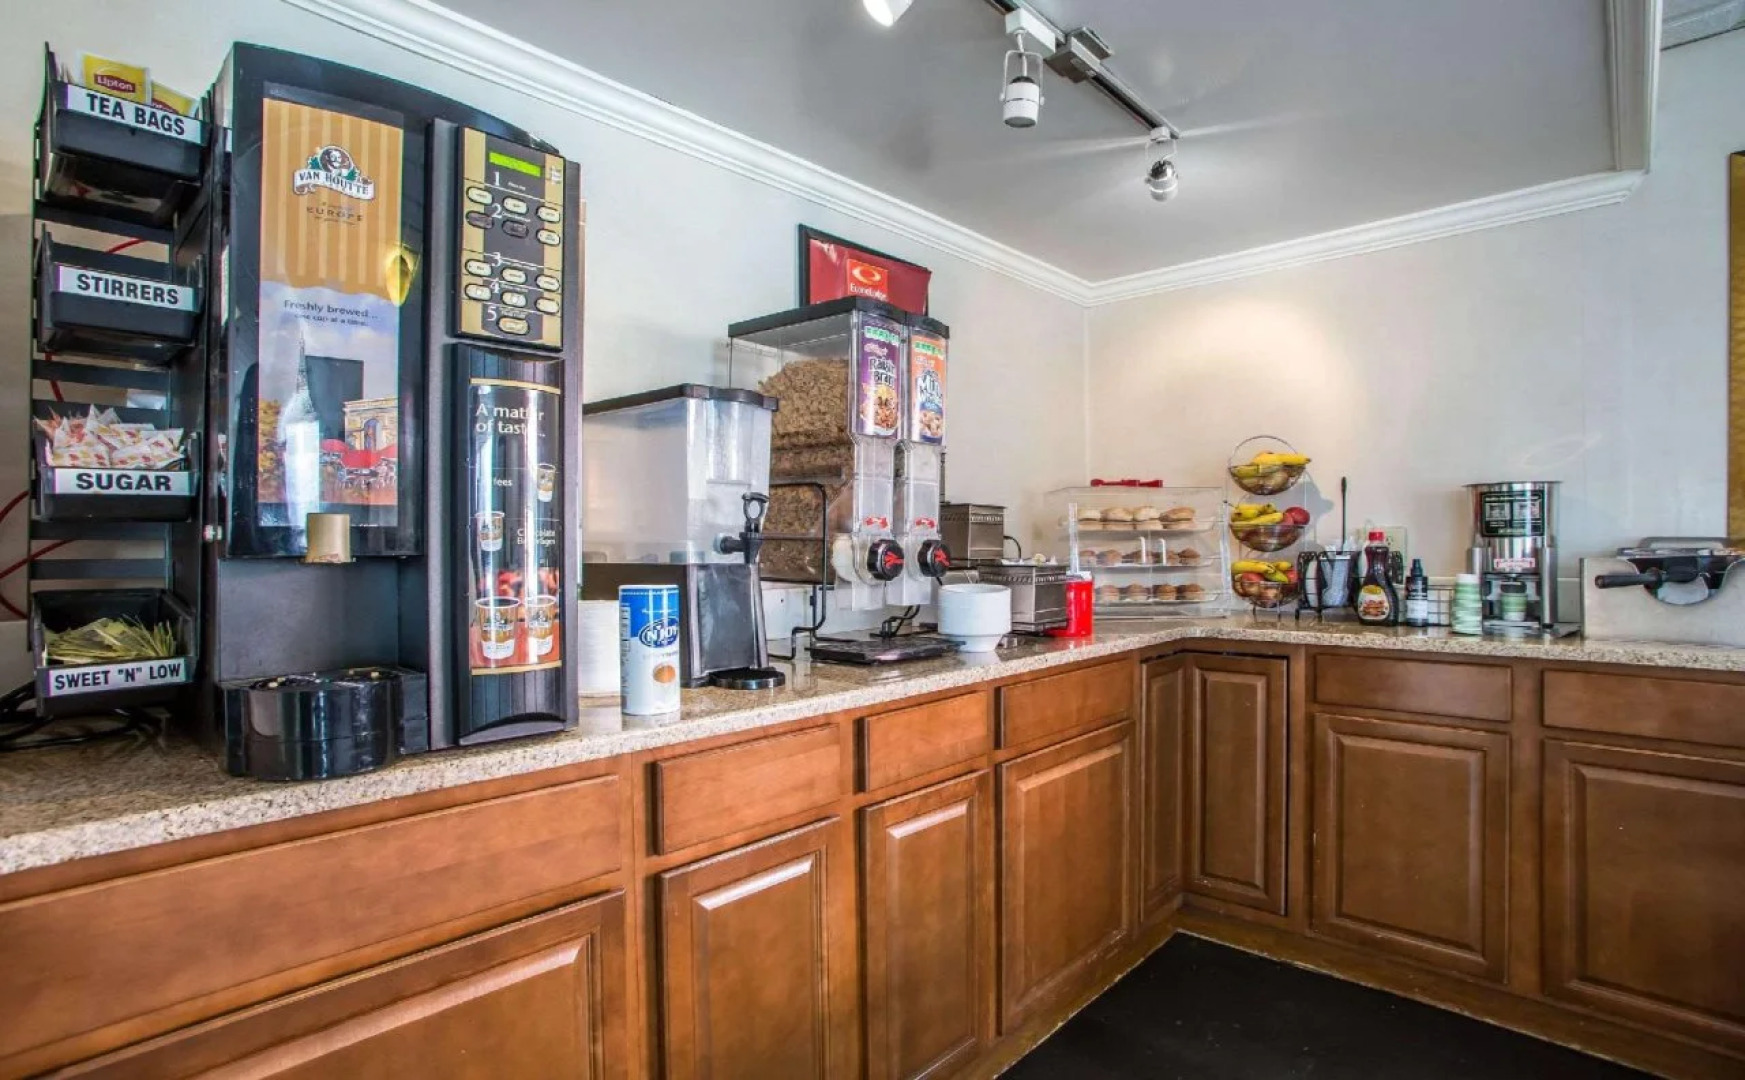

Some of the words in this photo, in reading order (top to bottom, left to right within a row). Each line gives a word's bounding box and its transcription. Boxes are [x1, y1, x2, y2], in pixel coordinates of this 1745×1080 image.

[97, 75, 133, 92] Lipton
[86, 93, 125, 119] TEA
[134, 106, 185, 135] BAGS
[299, 171, 320, 181] VAN
[325, 173, 369, 196] HOUTTE
[493, 171, 500, 186] 1
[491, 203, 502, 219] 2
[77, 273, 179, 305] STIRRERS
[284, 300, 323, 313] Freshly
[487, 306, 497, 321] 5
[475, 403, 488, 416] A
[493, 407, 545, 421] mattr
[475, 419, 494, 433] of
[76, 472, 171, 491] SUGAR
[55, 671, 110, 690] SWEET
[118, 667, 142, 683] "N"
[149, 663, 181, 680] LOW
